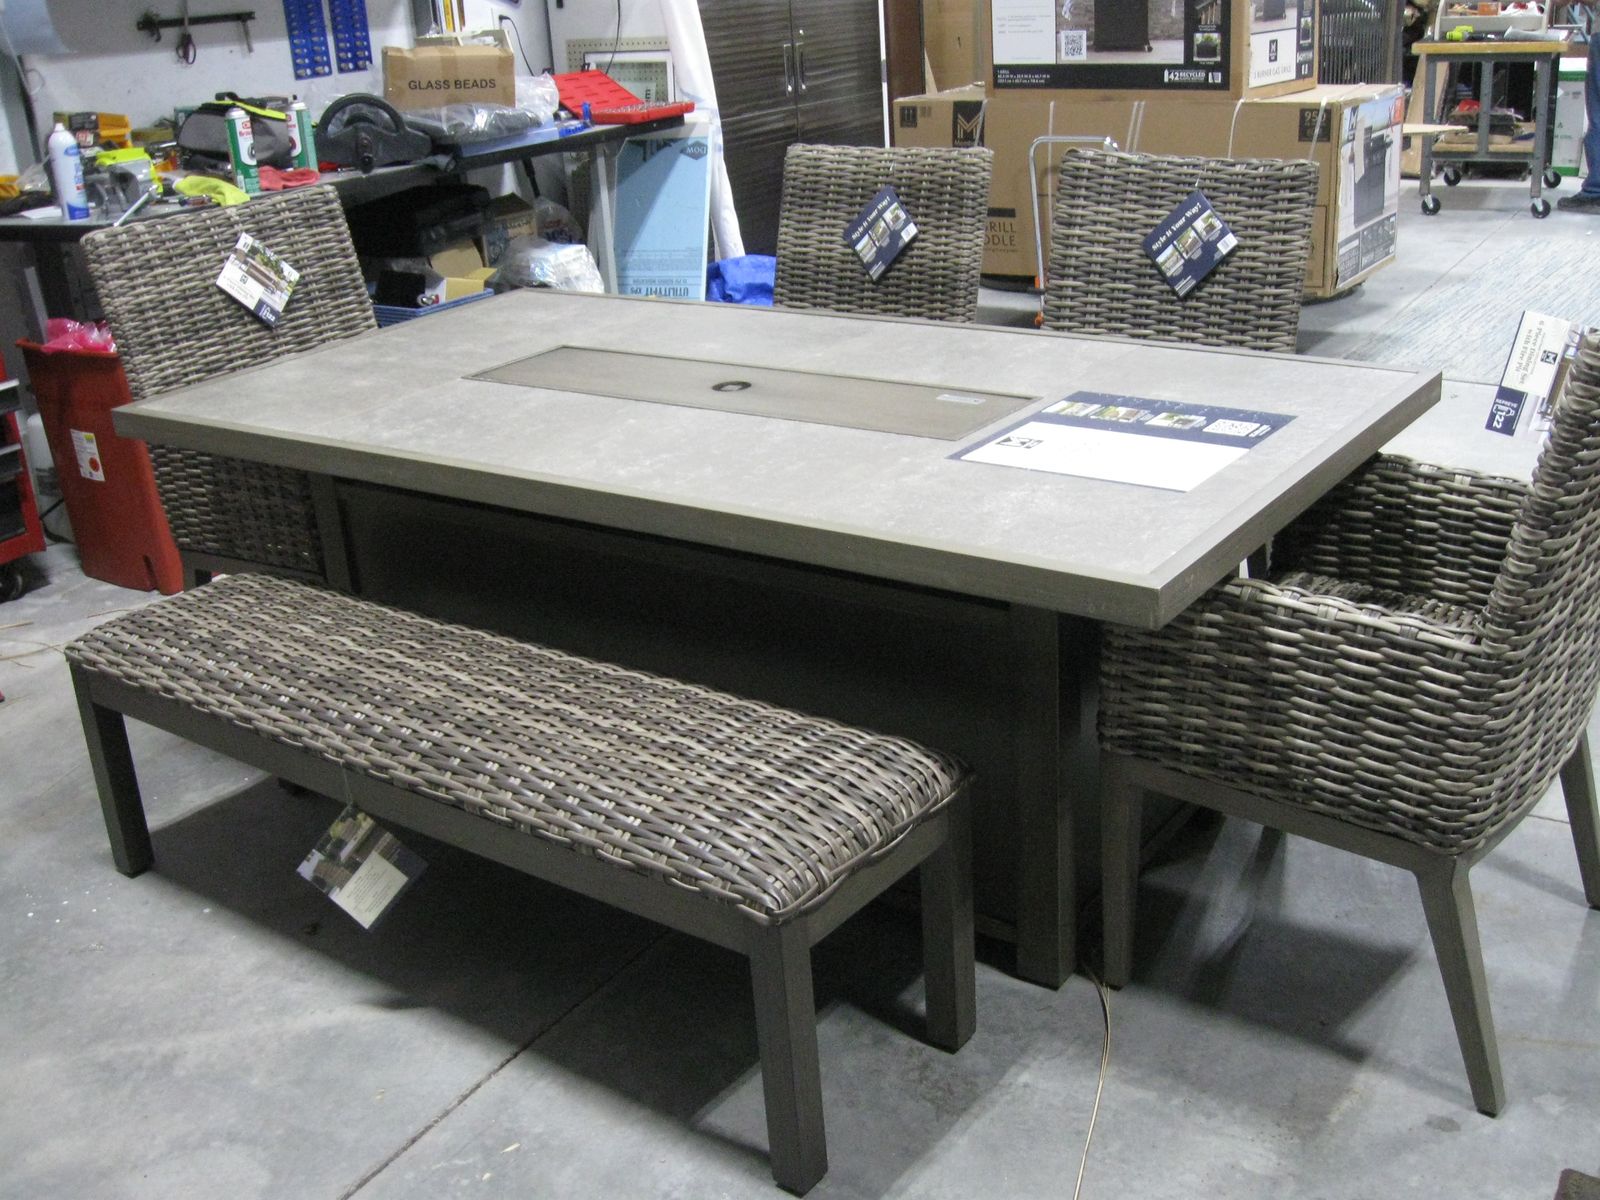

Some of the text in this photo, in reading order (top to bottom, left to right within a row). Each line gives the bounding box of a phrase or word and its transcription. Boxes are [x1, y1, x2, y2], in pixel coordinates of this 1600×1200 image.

[408, 79, 496, 90] GLASS BEADS
[686, 146, 707, 154] DOW
[985, 220, 1017, 233] RILL
[1152, 236, 1167, 251] Style
[1171, 216, 1186, 231] Your
[645, 287, 689, 297] UTILITYFIT
[1493, 411, 1507, 429] 122
